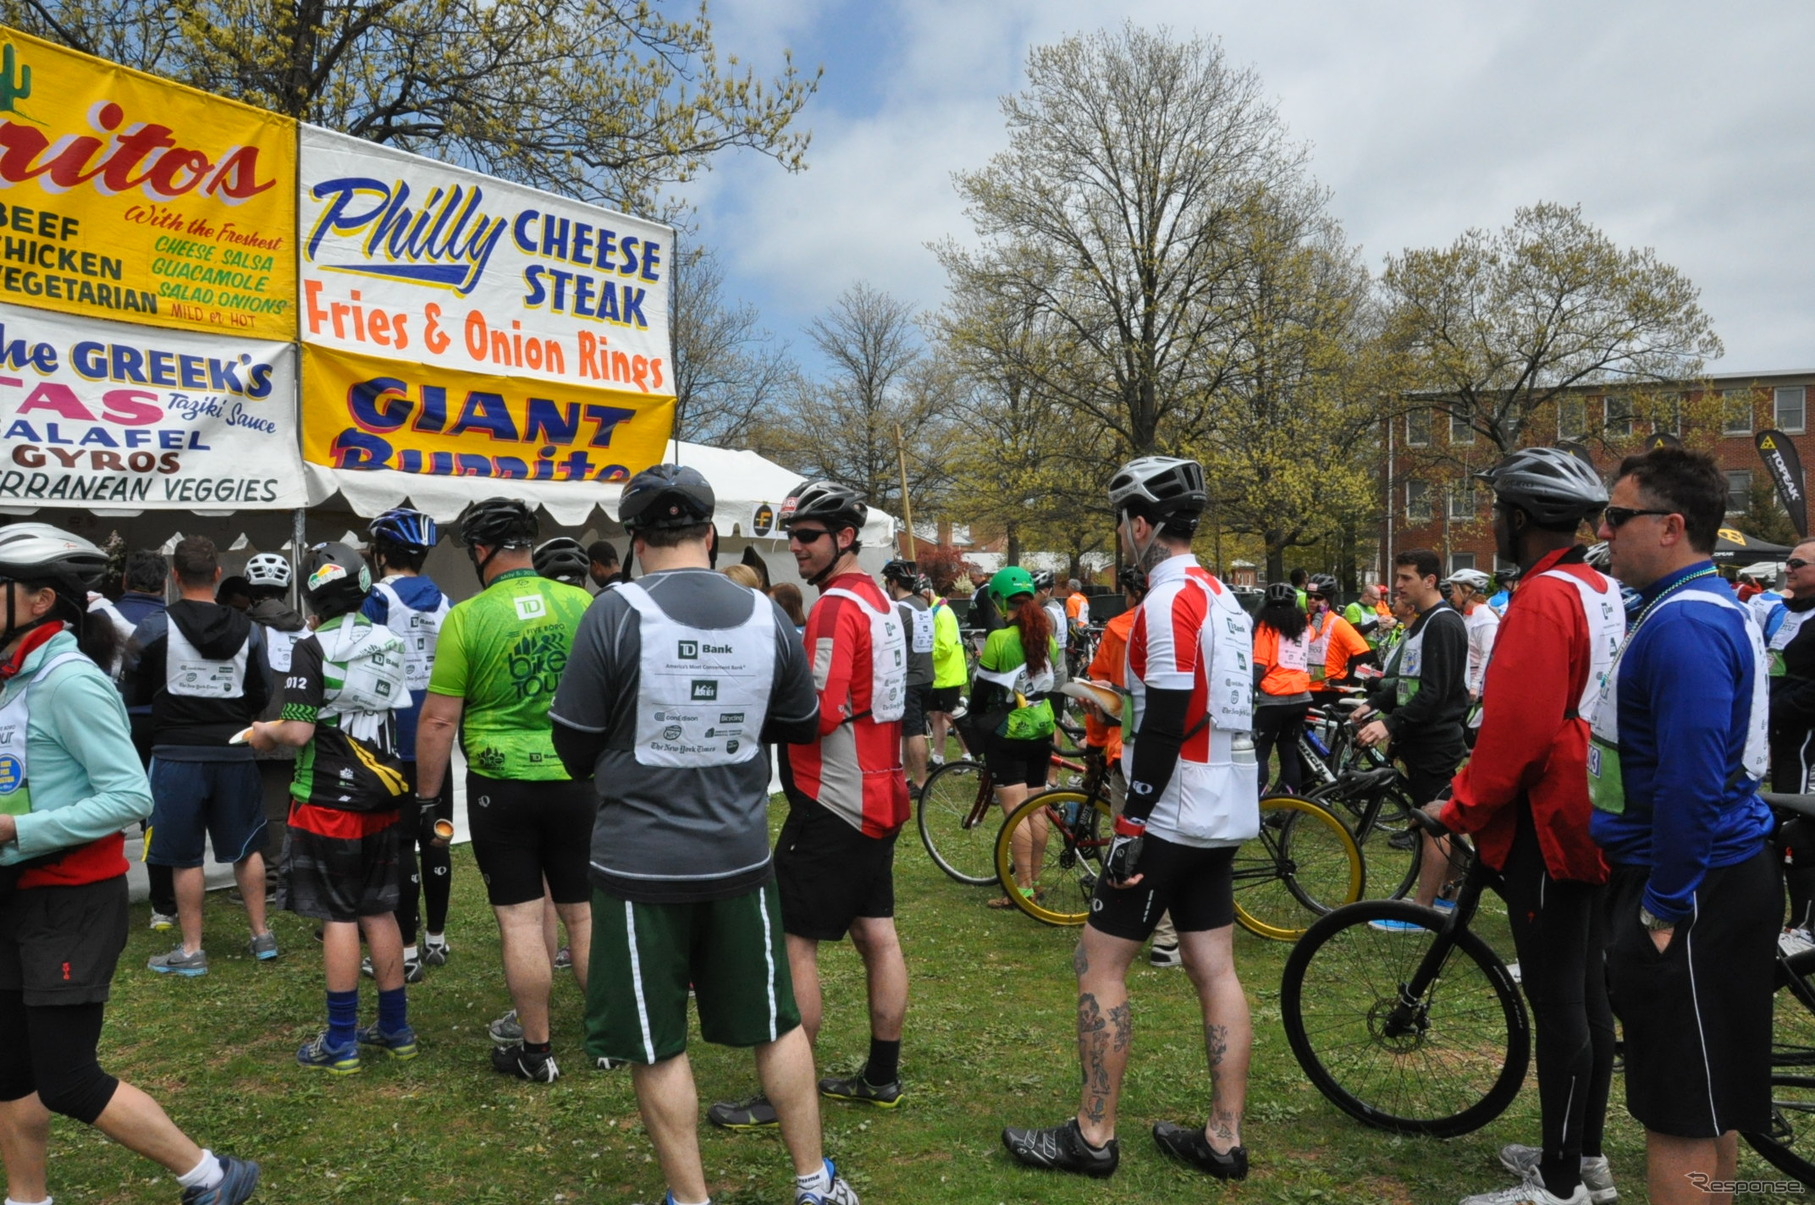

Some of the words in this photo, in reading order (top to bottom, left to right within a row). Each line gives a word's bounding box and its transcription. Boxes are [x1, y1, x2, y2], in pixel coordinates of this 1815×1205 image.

[124, 205, 184, 231] With
[187, 218, 215, 238] the
[216, 223, 284, 251] Freshest
[304, 177, 508, 299] Philly
[511, 209, 661, 284] CHEESE
[0, 236, 123, 281] HICKEN
[151, 257, 270, 293] GUACAMOLE
[221, 248, 275, 272] SALSA
[0, 264, 159, 315] EGETARIAN
[218, 292, 288, 315] ONIONS
[522, 264, 649, 331] STEAK
[170, 303, 204, 322] MILD
[209, 311, 224, 325] or
[230, 312, 256, 328] HOT
[304, 279, 409, 350] Fries
[424, 302, 451, 354] &
[464, 309, 566, 375] Onion
[577, 330, 664, 393] Rings
[70, 340, 274, 400] GREEK'S
[168, 393, 229, 421] Taziki
[226, 402, 277, 434] Sauce
[347, 376, 637, 449] GIANT
[0, 419, 211, 451] ALAFEL
[12, 444, 181, 475] GYROS
[1772, 449, 1800, 501] TOPEAK
[0, 470, 153, 501] RRANEAN
[165, 478, 278, 502] VEGGIES
[518, 599, 541, 614] TD
[526, 627, 542, 635] FIVE
[544, 623, 566, 632] BORO
[702, 644, 733, 654] Bank
[284, 676, 308, 690] 012
[651, 741, 663, 750] The
[664, 743, 679, 752] New
[697, 745, 716, 753] Times
